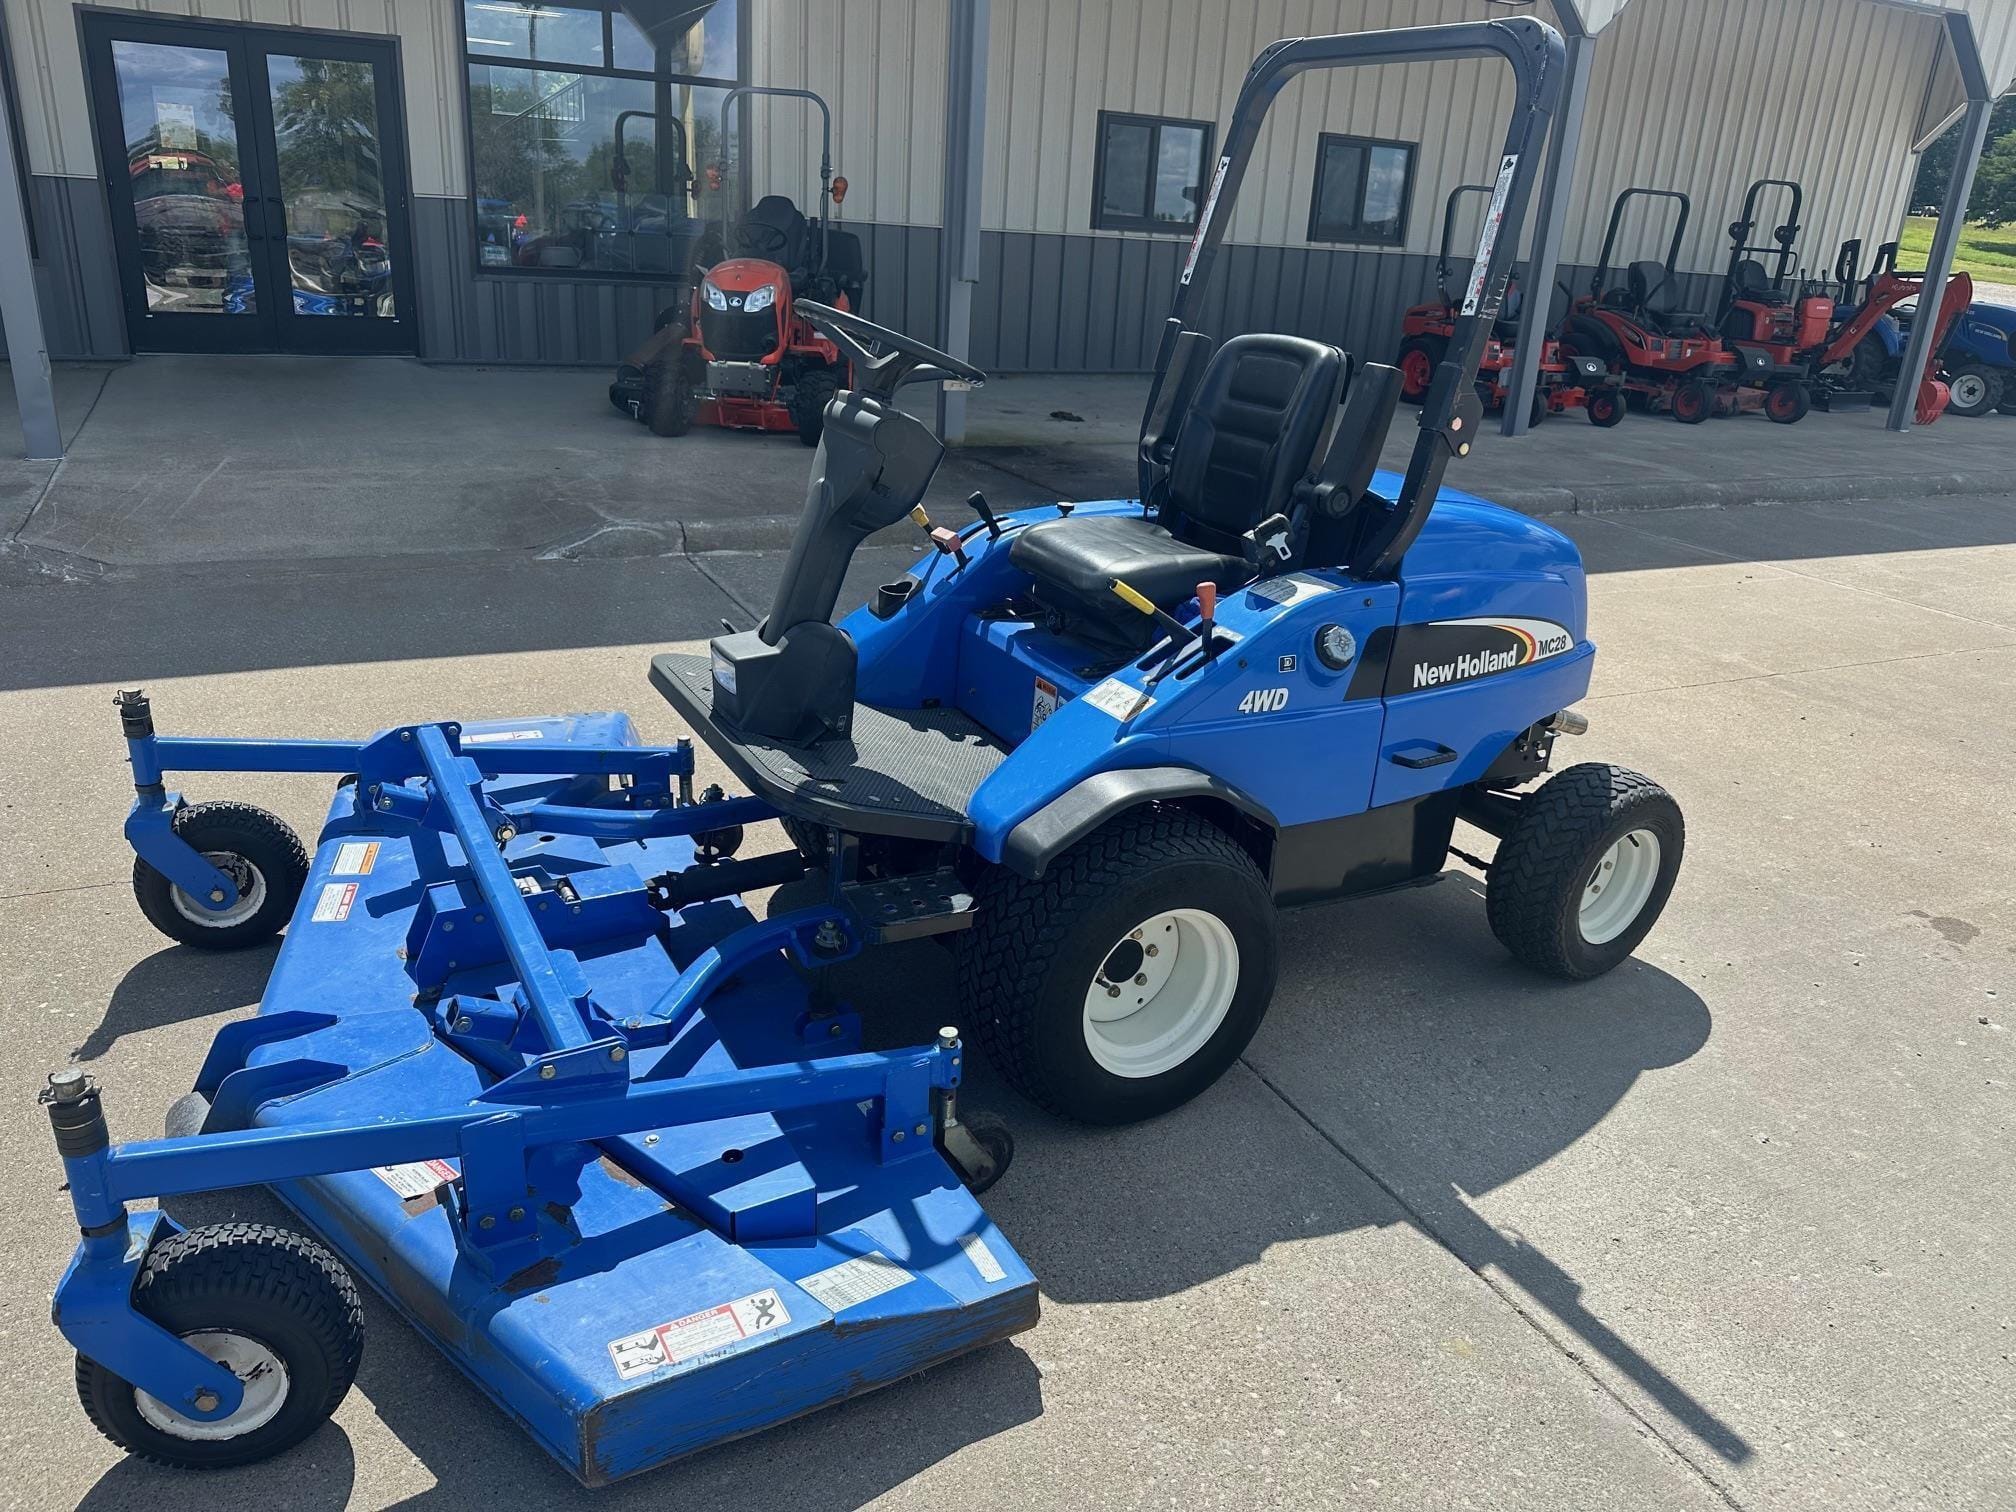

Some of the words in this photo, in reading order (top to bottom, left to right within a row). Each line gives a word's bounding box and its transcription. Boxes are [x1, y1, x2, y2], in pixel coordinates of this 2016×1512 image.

[1538, 634, 1567, 657] MC28
[1413, 662, 1455, 688] New
[1456, 643, 1518, 680] Holland
[1238, 687, 1289, 714] 4WD
[678, 1309, 719, 1328] DANGER
